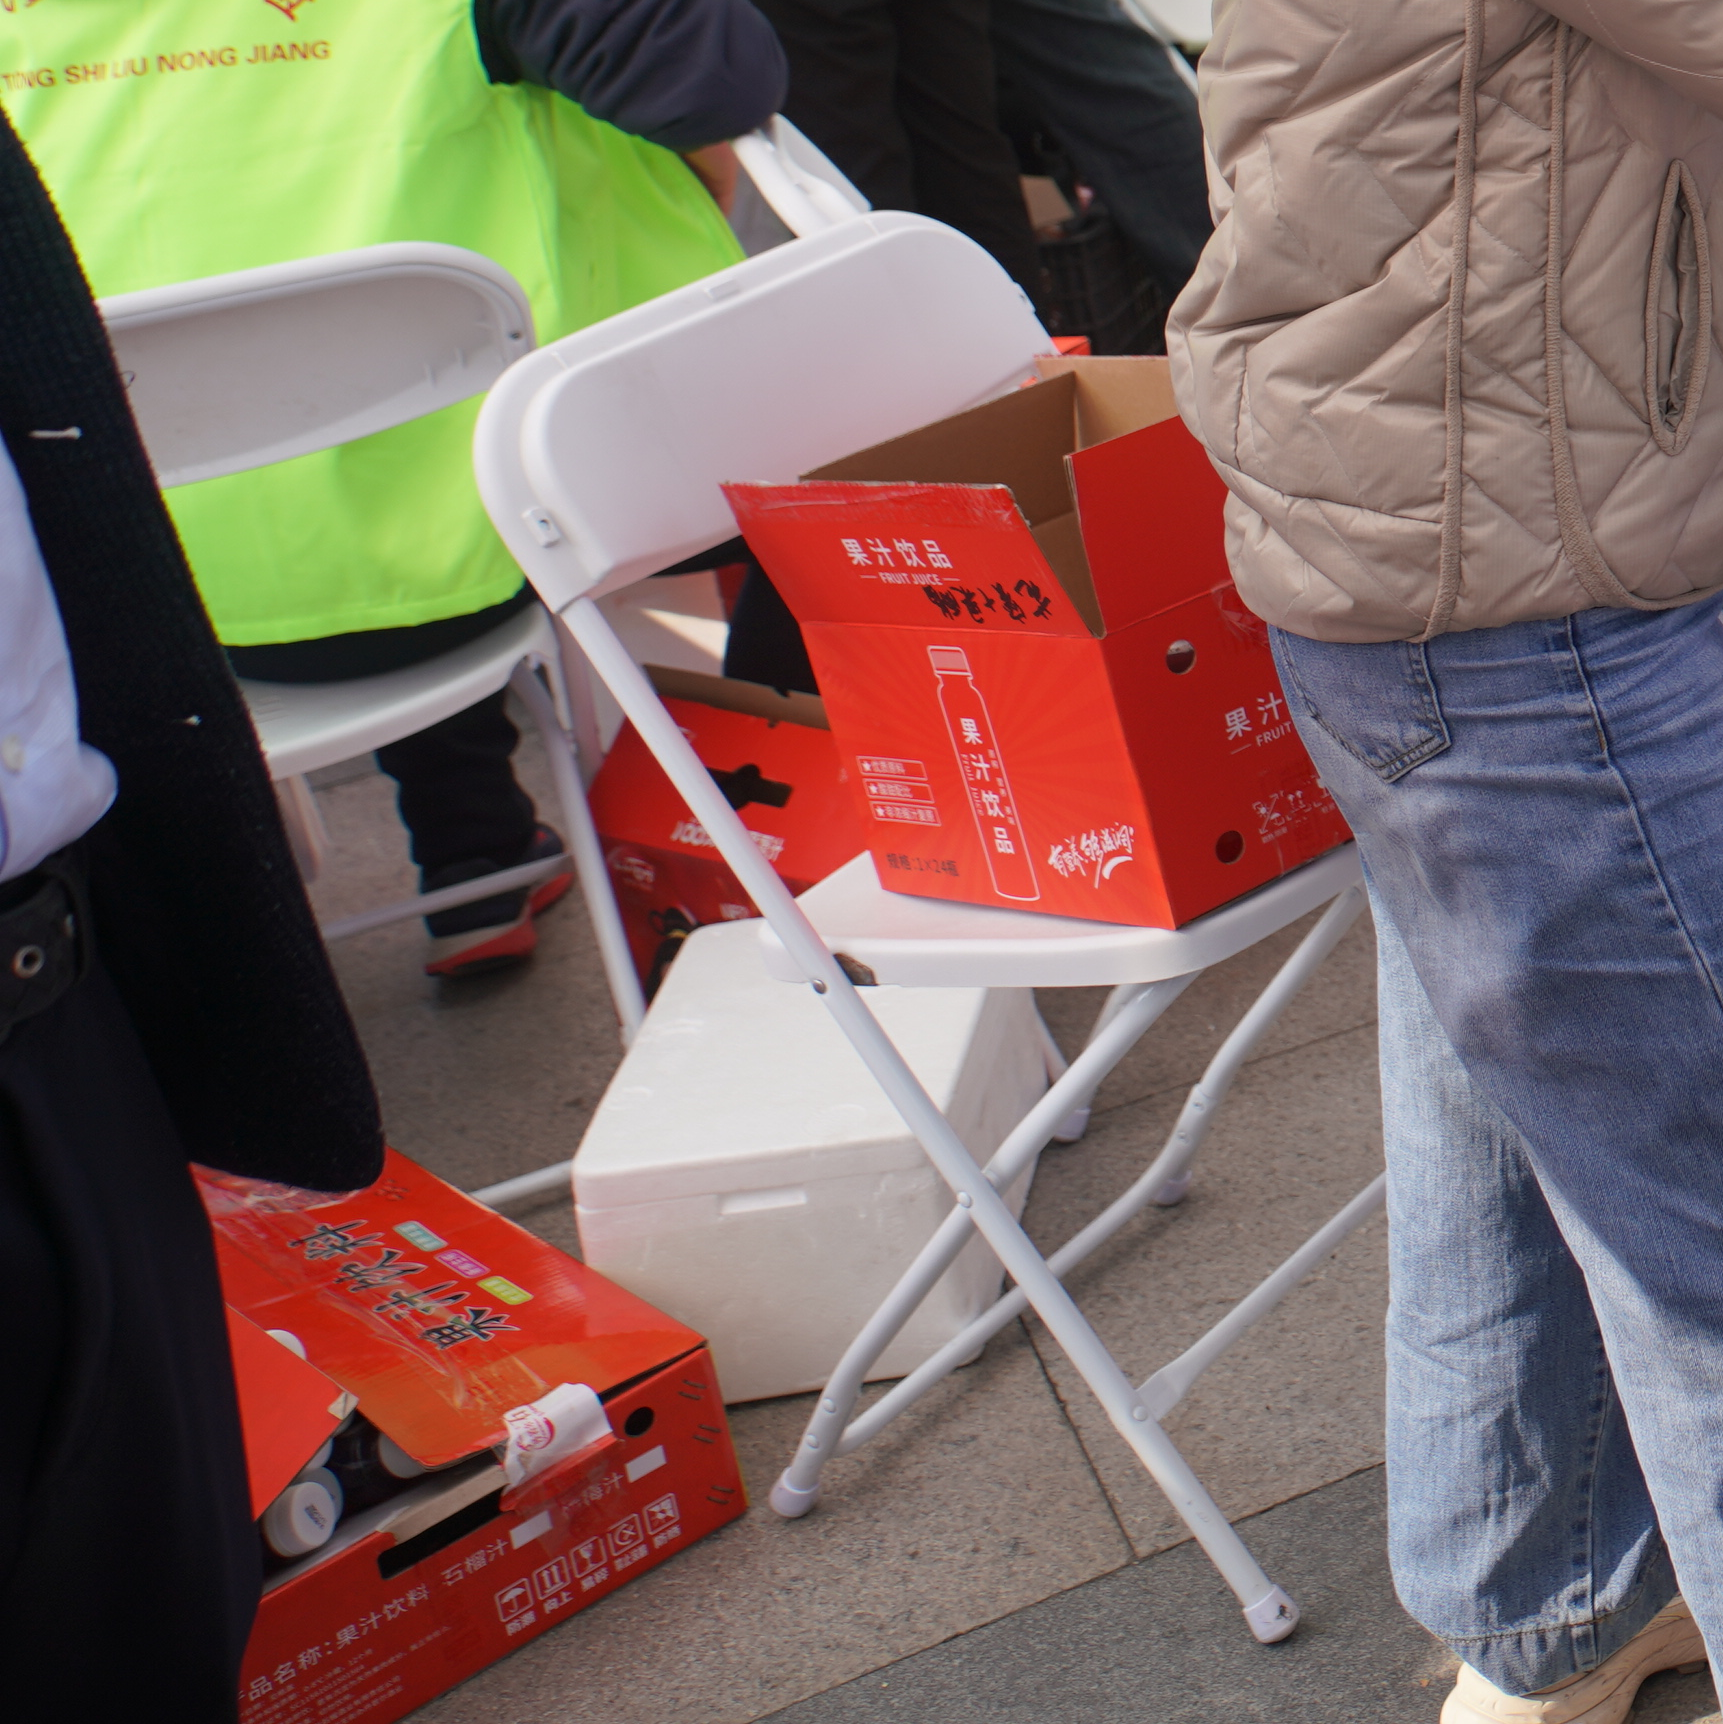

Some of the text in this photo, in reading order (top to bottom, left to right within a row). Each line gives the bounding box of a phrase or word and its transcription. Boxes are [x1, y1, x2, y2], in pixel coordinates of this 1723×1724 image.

[157, 46, 237, 74] NONG
[247, 39, 331, 64] JIANG
[840, 537, 954, 569] 果汁饮品
[879, 571, 944, 586] FRUIT JUICE
[1255, 720, 1293, 748] FRUIT
[960, 717, 1016, 855] 果汁饮品
